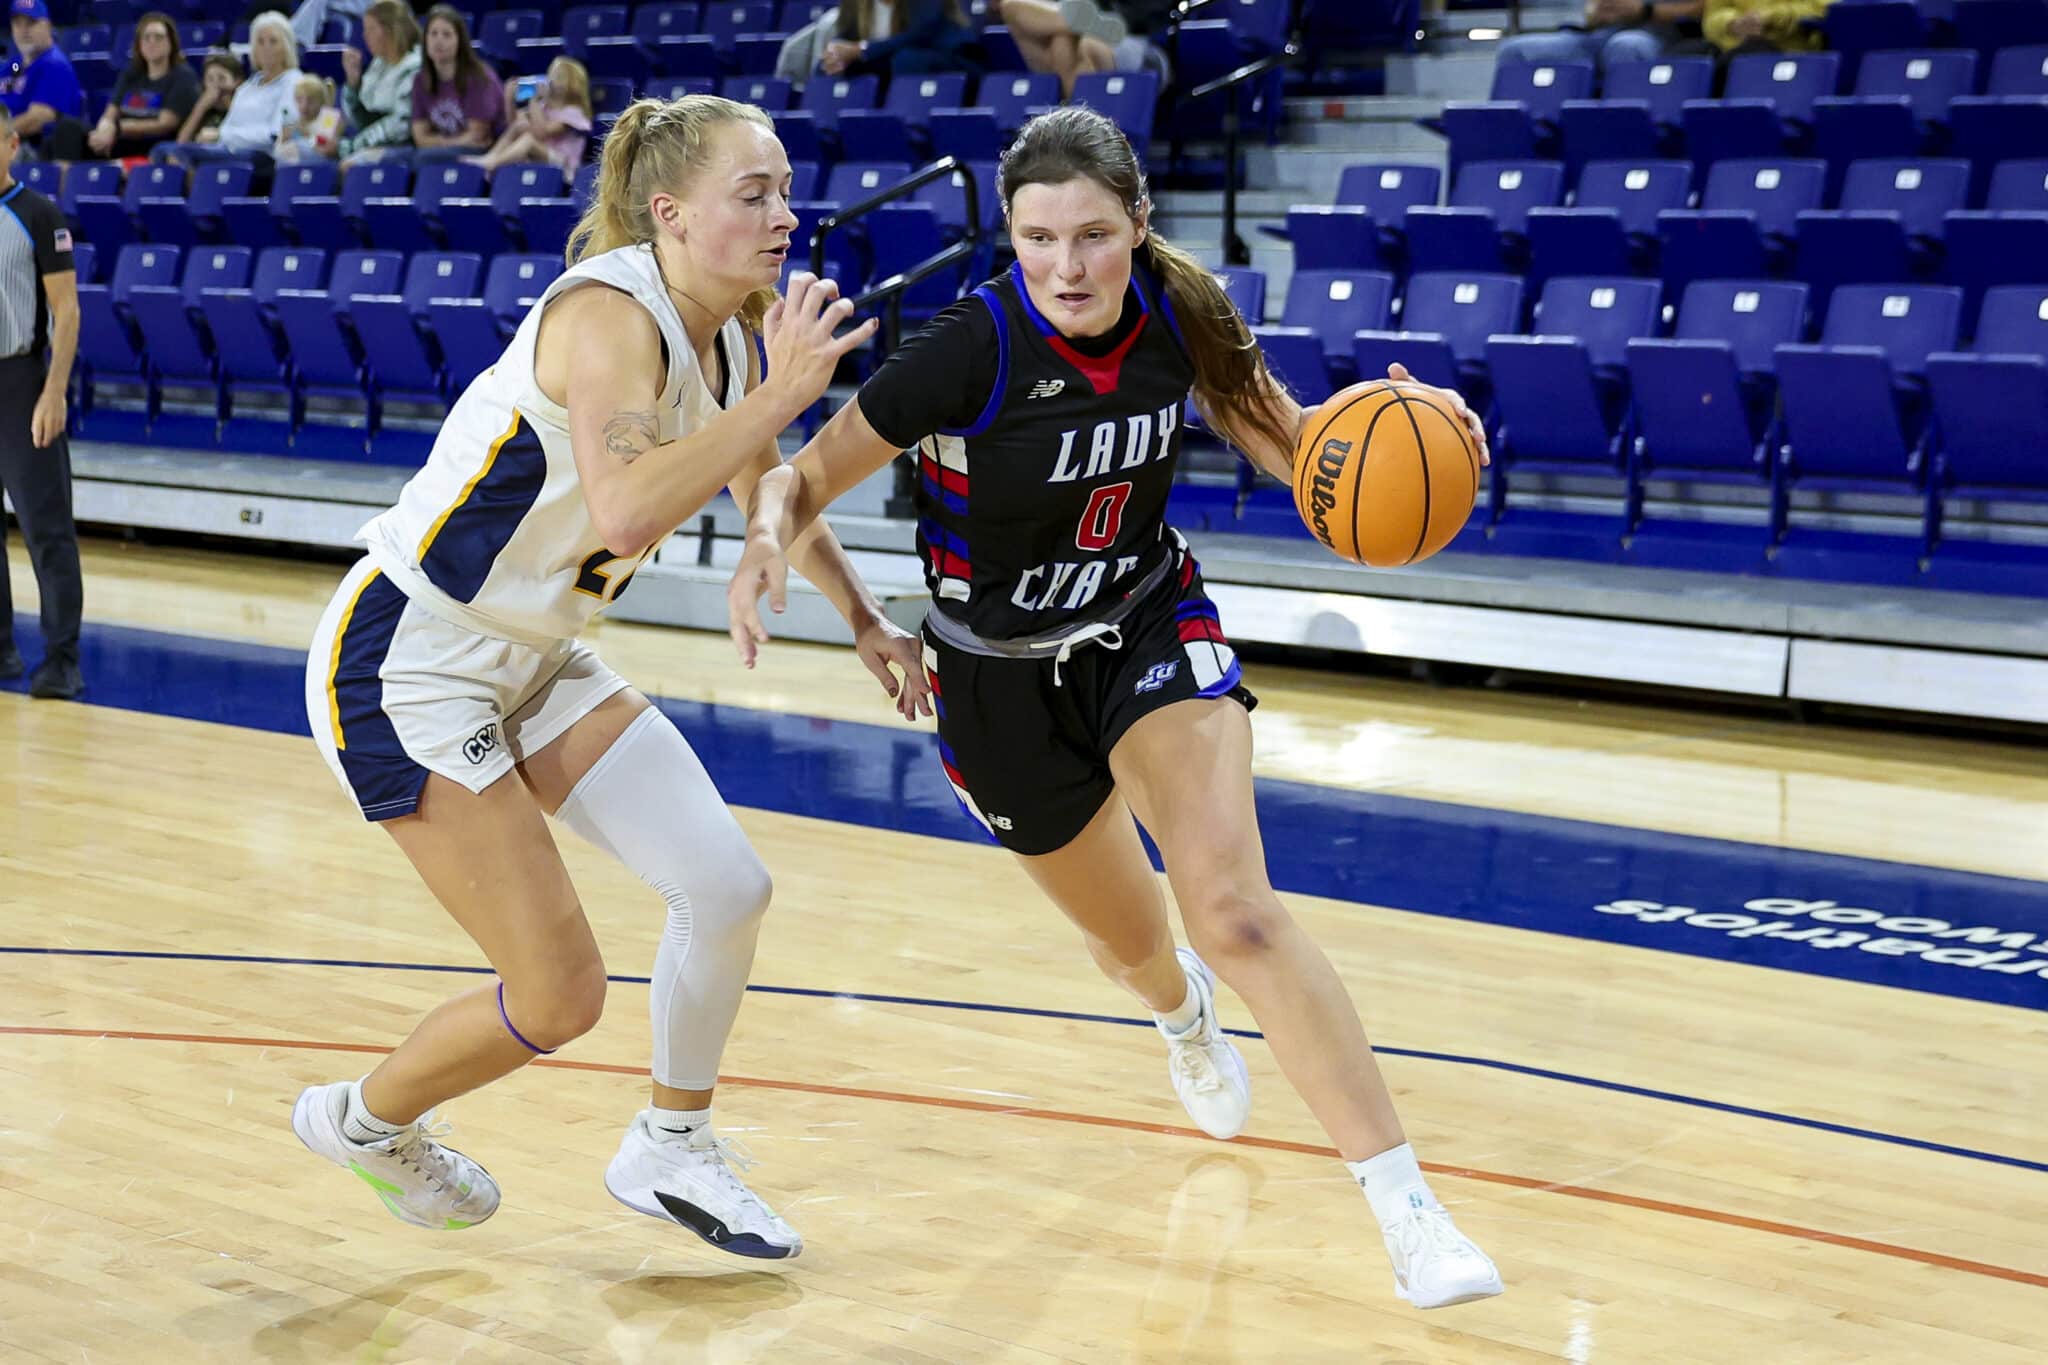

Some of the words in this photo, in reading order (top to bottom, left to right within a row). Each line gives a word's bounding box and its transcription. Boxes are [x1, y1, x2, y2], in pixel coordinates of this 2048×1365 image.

[1047, 402, 1178, 483] LADY
[1075, 481, 1133, 551] 0
[1311, 438, 1353, 550] Wilson
[571, 546, 638, 604] 2
